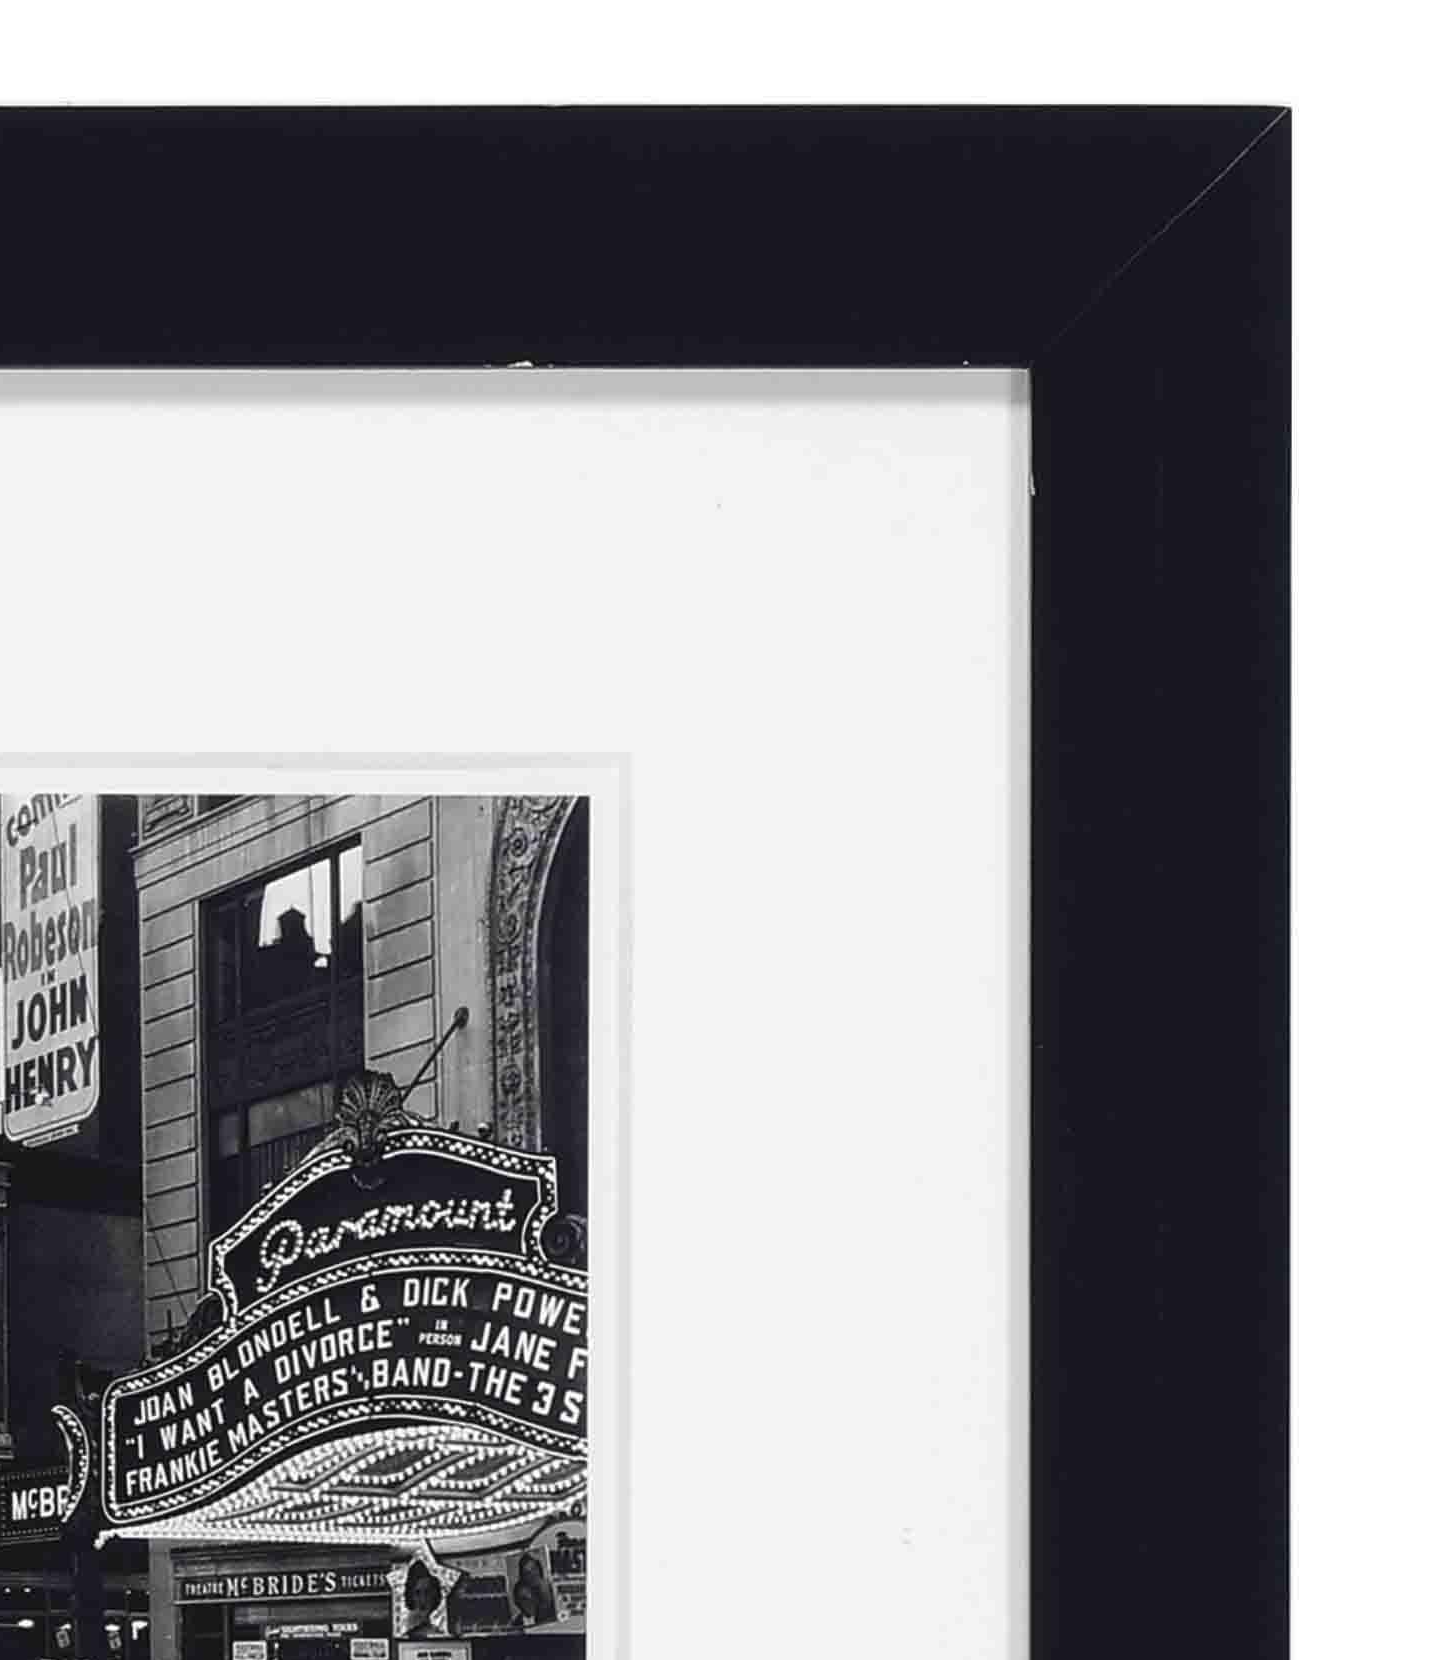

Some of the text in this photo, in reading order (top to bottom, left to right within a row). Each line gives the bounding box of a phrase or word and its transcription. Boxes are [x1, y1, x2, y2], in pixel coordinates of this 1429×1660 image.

[20, 823, 78, 912] Paul
[4, 897, 96, 985] Robeson
[11, 972, 88, 1051] JOHN
[4, 1035, 97, 1115] HENRY
[257, 1189, 516, 1294] Paramount
[133, 1276, 587, 1427] JOAN BLONDELL & DICK POWE
[418, 1333, 462, 1346] PERSON
[435, 1319, 448, 1332] IN
[159, 1397, 225, 1452] WANT
[242, 1377, 260, 1406] A
[273, 1317, 410, 1385] DIVORCE"
[470, 1321, 558, 1372] JANE
[125, 1438, 223, 1496] FRANKIE
[531, 1380, 557, 1416] 3
